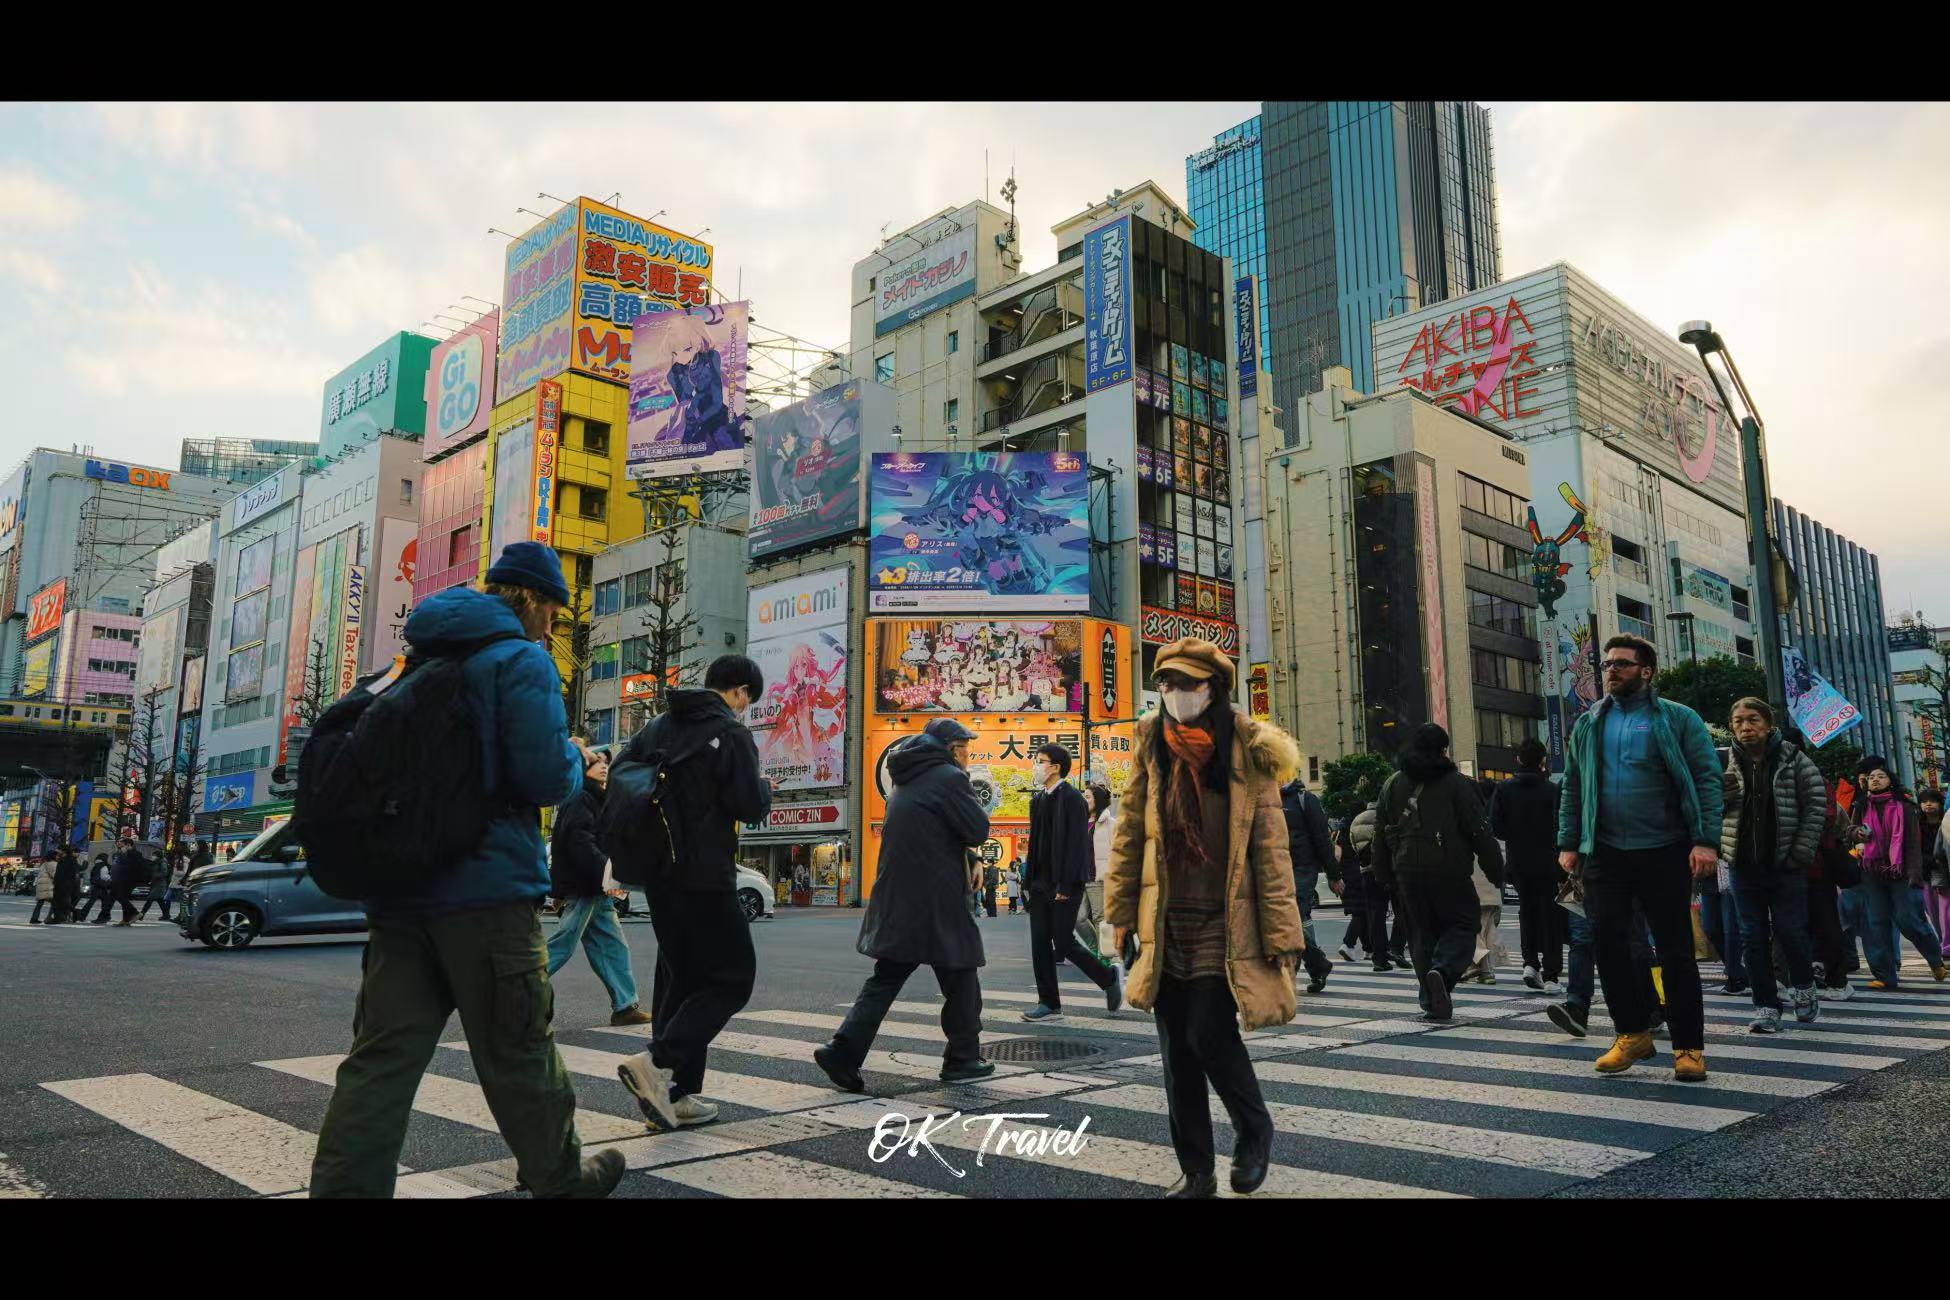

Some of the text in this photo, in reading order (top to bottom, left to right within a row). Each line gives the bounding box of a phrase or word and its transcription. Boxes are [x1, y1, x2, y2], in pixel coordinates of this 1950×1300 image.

[584, 209, 710, 268] MEDIAリサイクル
[583, 238, 707, 307] 激安販売
[1399, 296, 1533, 373] AKIBA
[440, 381, 476, 430] GO
[1153, 391, 1170, 410] 7F
[1434, 371, 1541, 422] ONE
[1156, 467, 1172, 485] 6F
[1158, 545, 1174, 565] 5F
[347, 568, 363, 615] AKKY
[758, 587, 837, 625] amiami
[1144, 611, 1236, 651] メイドカジノ
[341, 627, 358, 690] Tax-free
[771, 808, 822, 824] COMIC ZIN
